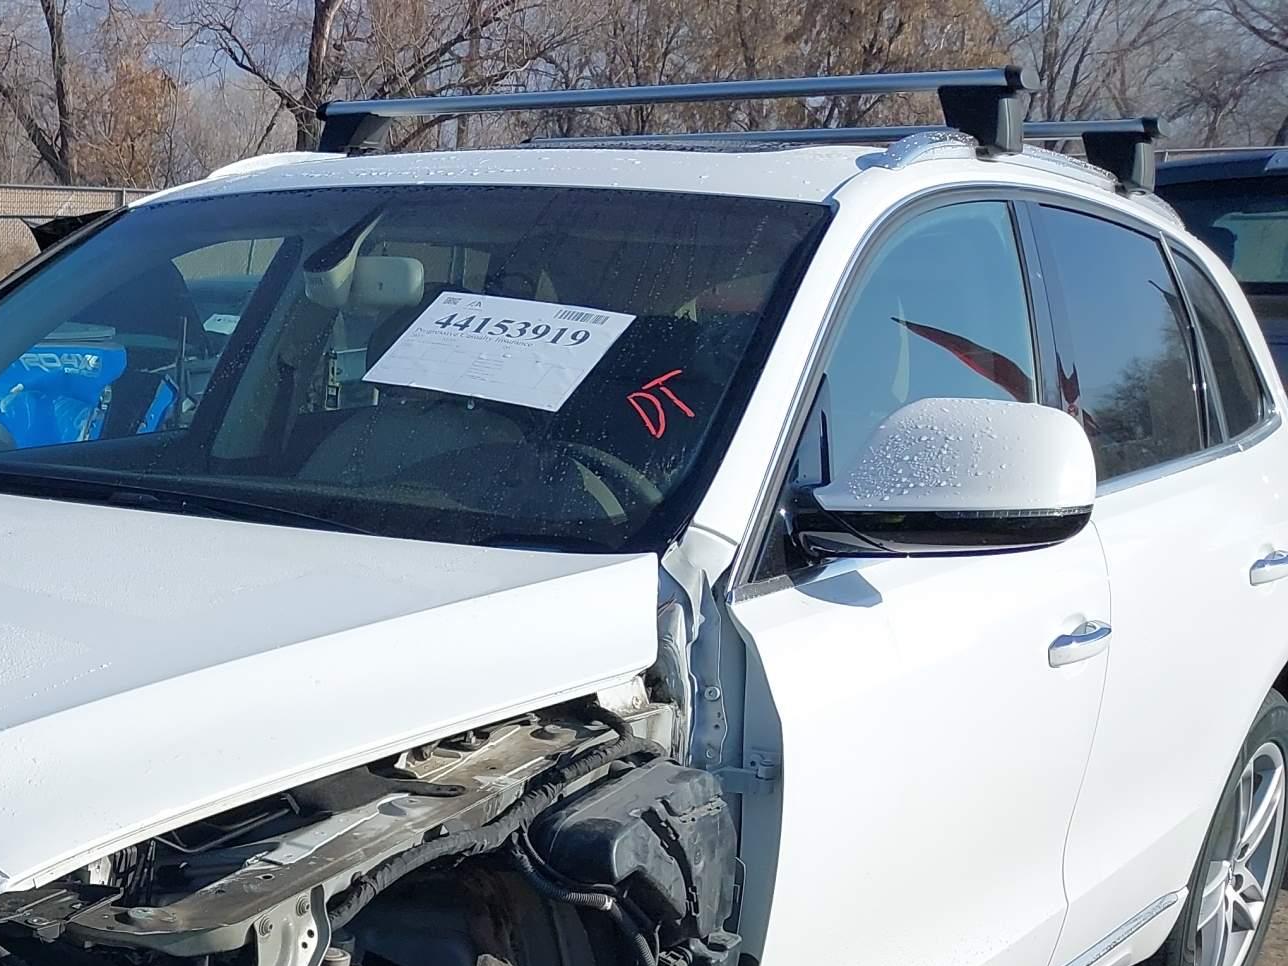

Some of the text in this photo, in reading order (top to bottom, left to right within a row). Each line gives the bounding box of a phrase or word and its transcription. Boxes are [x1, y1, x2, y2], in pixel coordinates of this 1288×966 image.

[414, 327, 458, 338] Progressive
[459, 332, 493, 342] Casualty
[494, 336, 534, 347] Insurance
[434, 312, 592, 348] 44153919
[626, 369, 696, 439] DT
